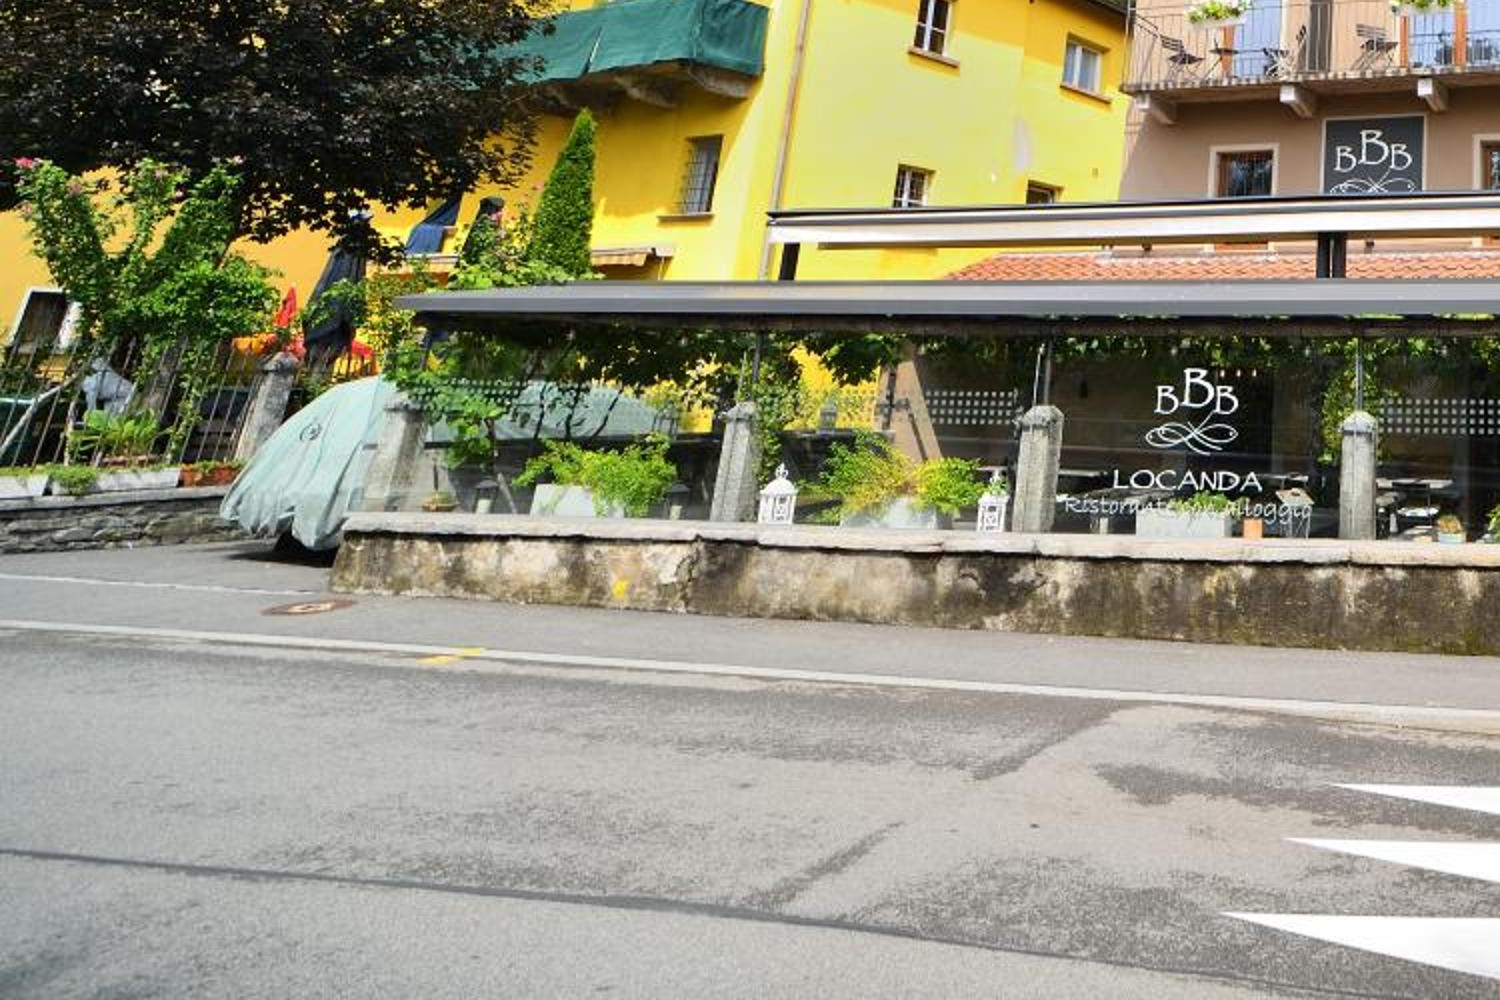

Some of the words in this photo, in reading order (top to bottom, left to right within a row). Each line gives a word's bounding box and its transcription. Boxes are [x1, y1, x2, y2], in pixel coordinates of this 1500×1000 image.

[1334, 129, 1412, 172] BBB
[1153, 368, 1239, 415] BBB
[1112, 469, 1263, 492] LOCANDA
